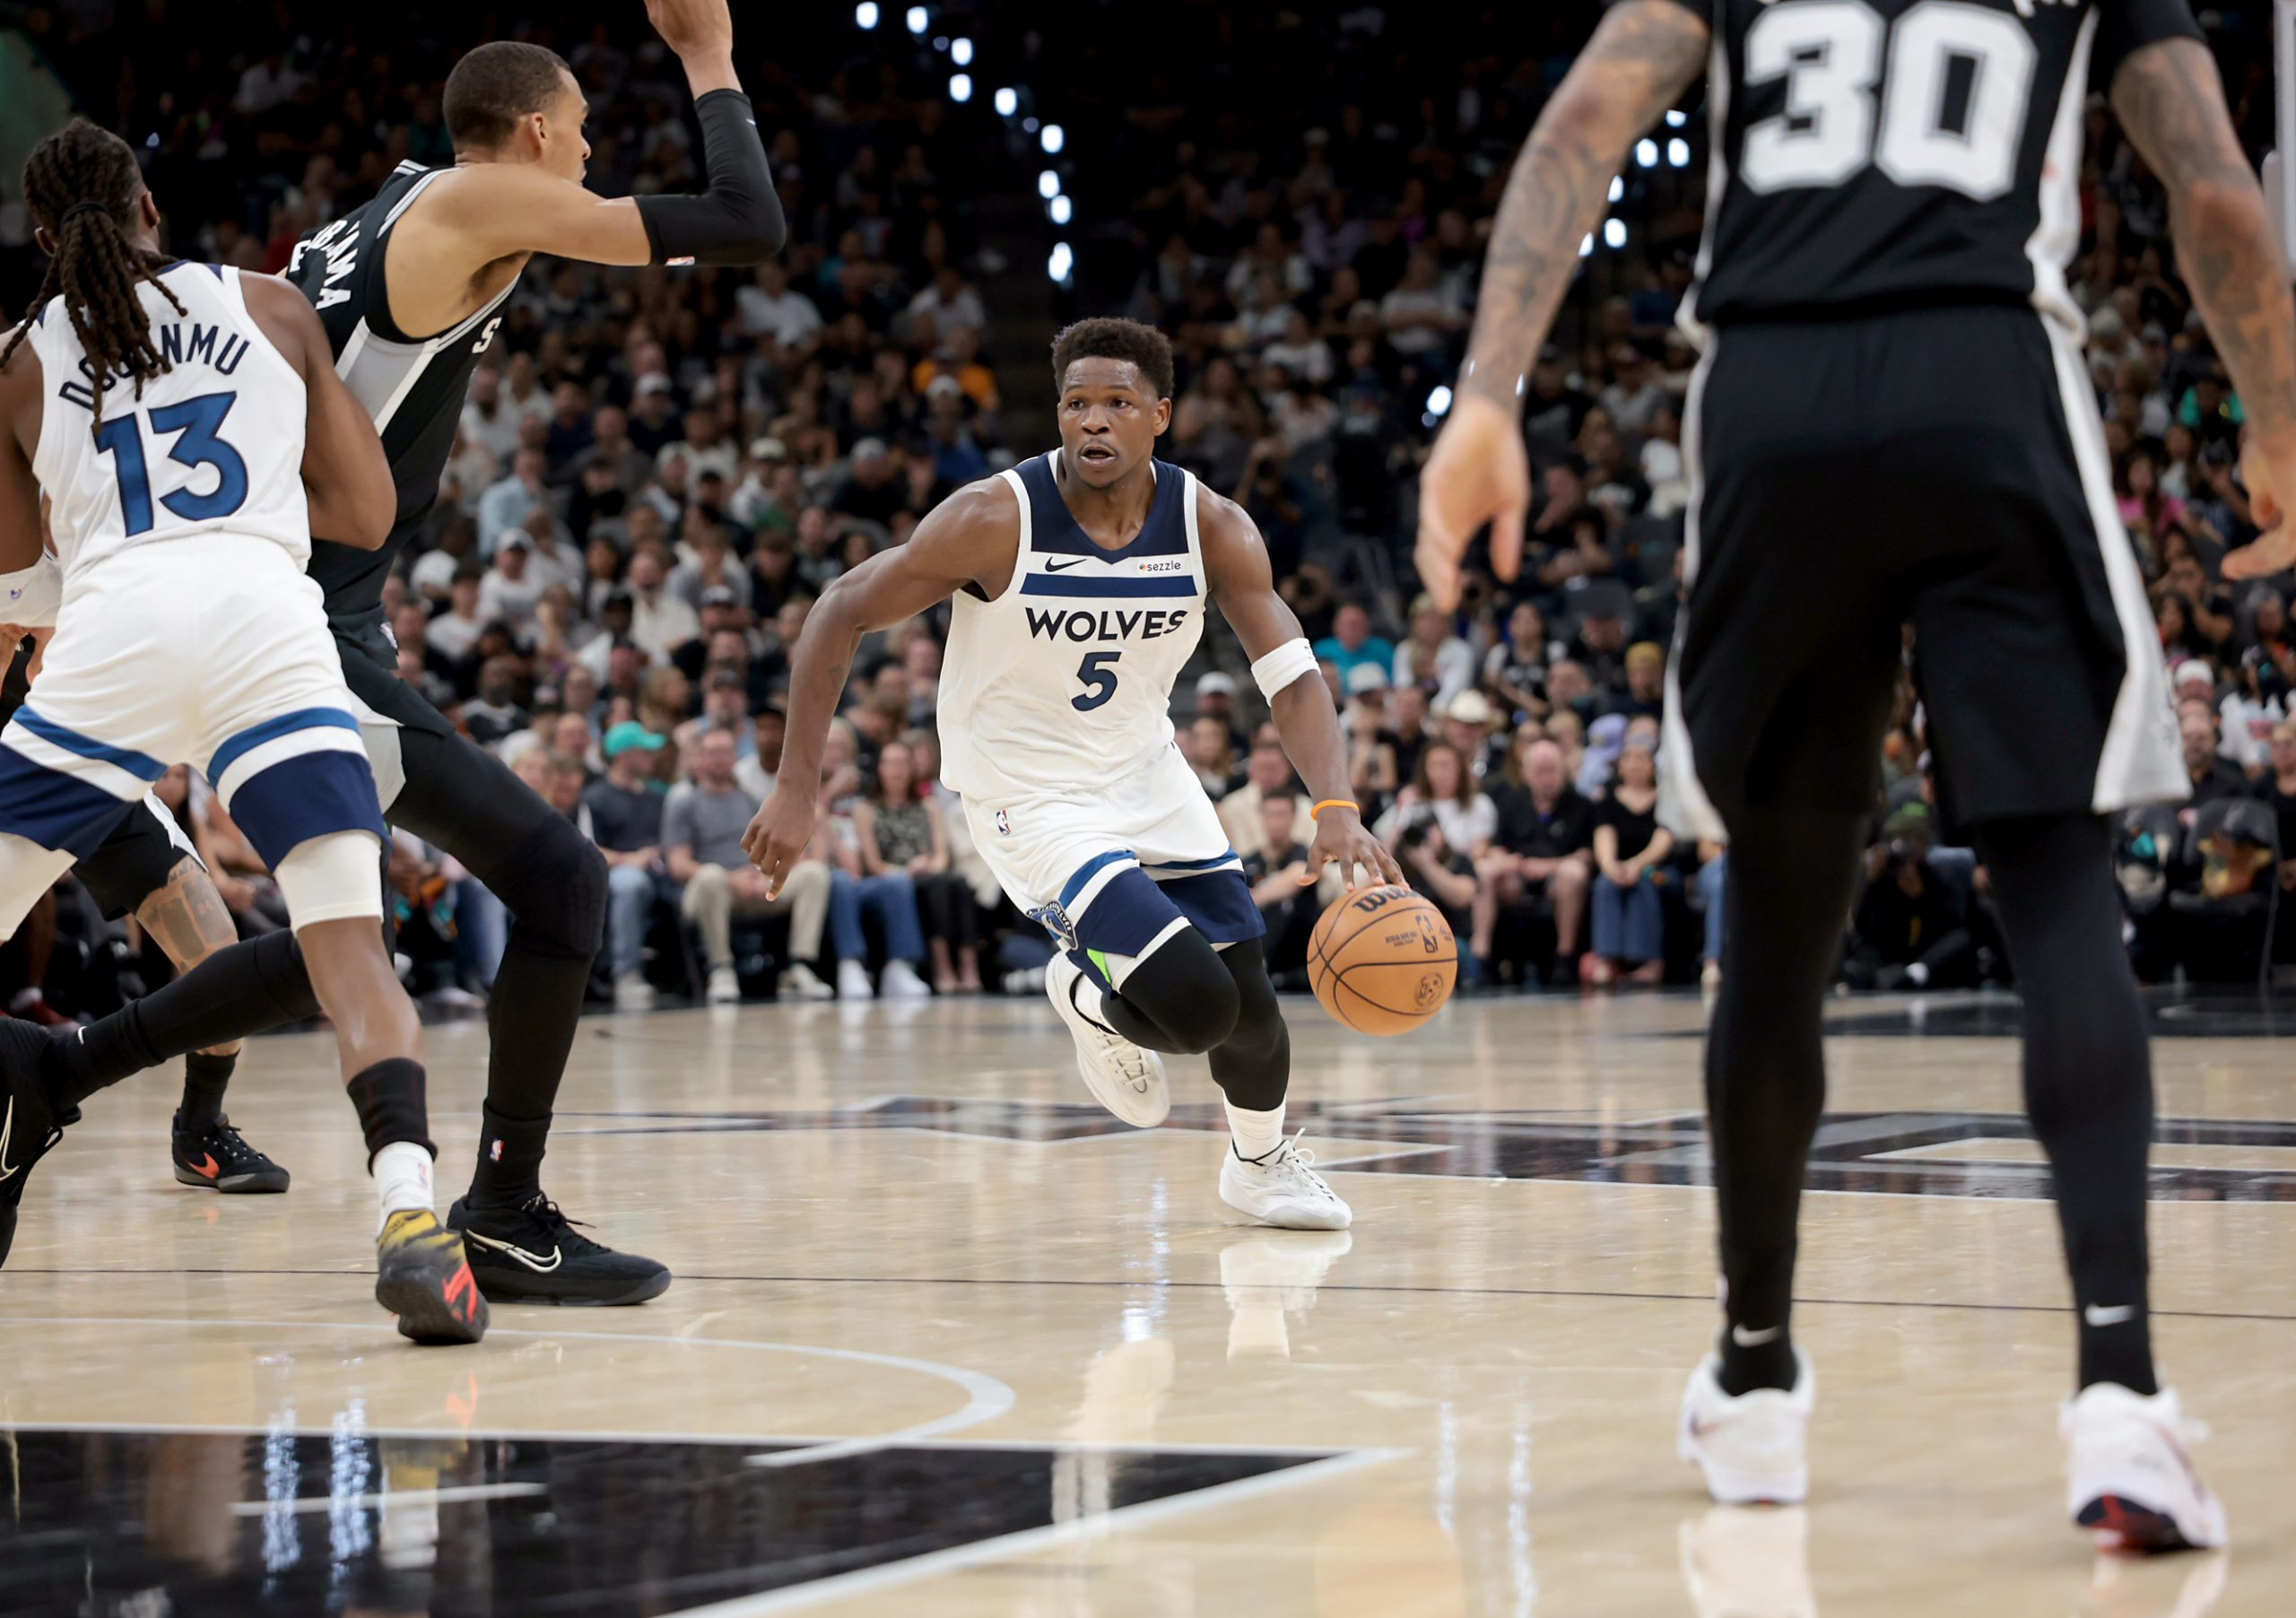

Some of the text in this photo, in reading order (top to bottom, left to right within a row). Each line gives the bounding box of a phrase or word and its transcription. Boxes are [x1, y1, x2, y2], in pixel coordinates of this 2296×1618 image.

[1740, 0, 2039, 203] 30
[91, 390, 248, 537] 13
[1147, 561, 1181, 571] sezzle
[1025, 607, 1188, 642] WOLVES
[1071, 652, 1122, 712] 5
